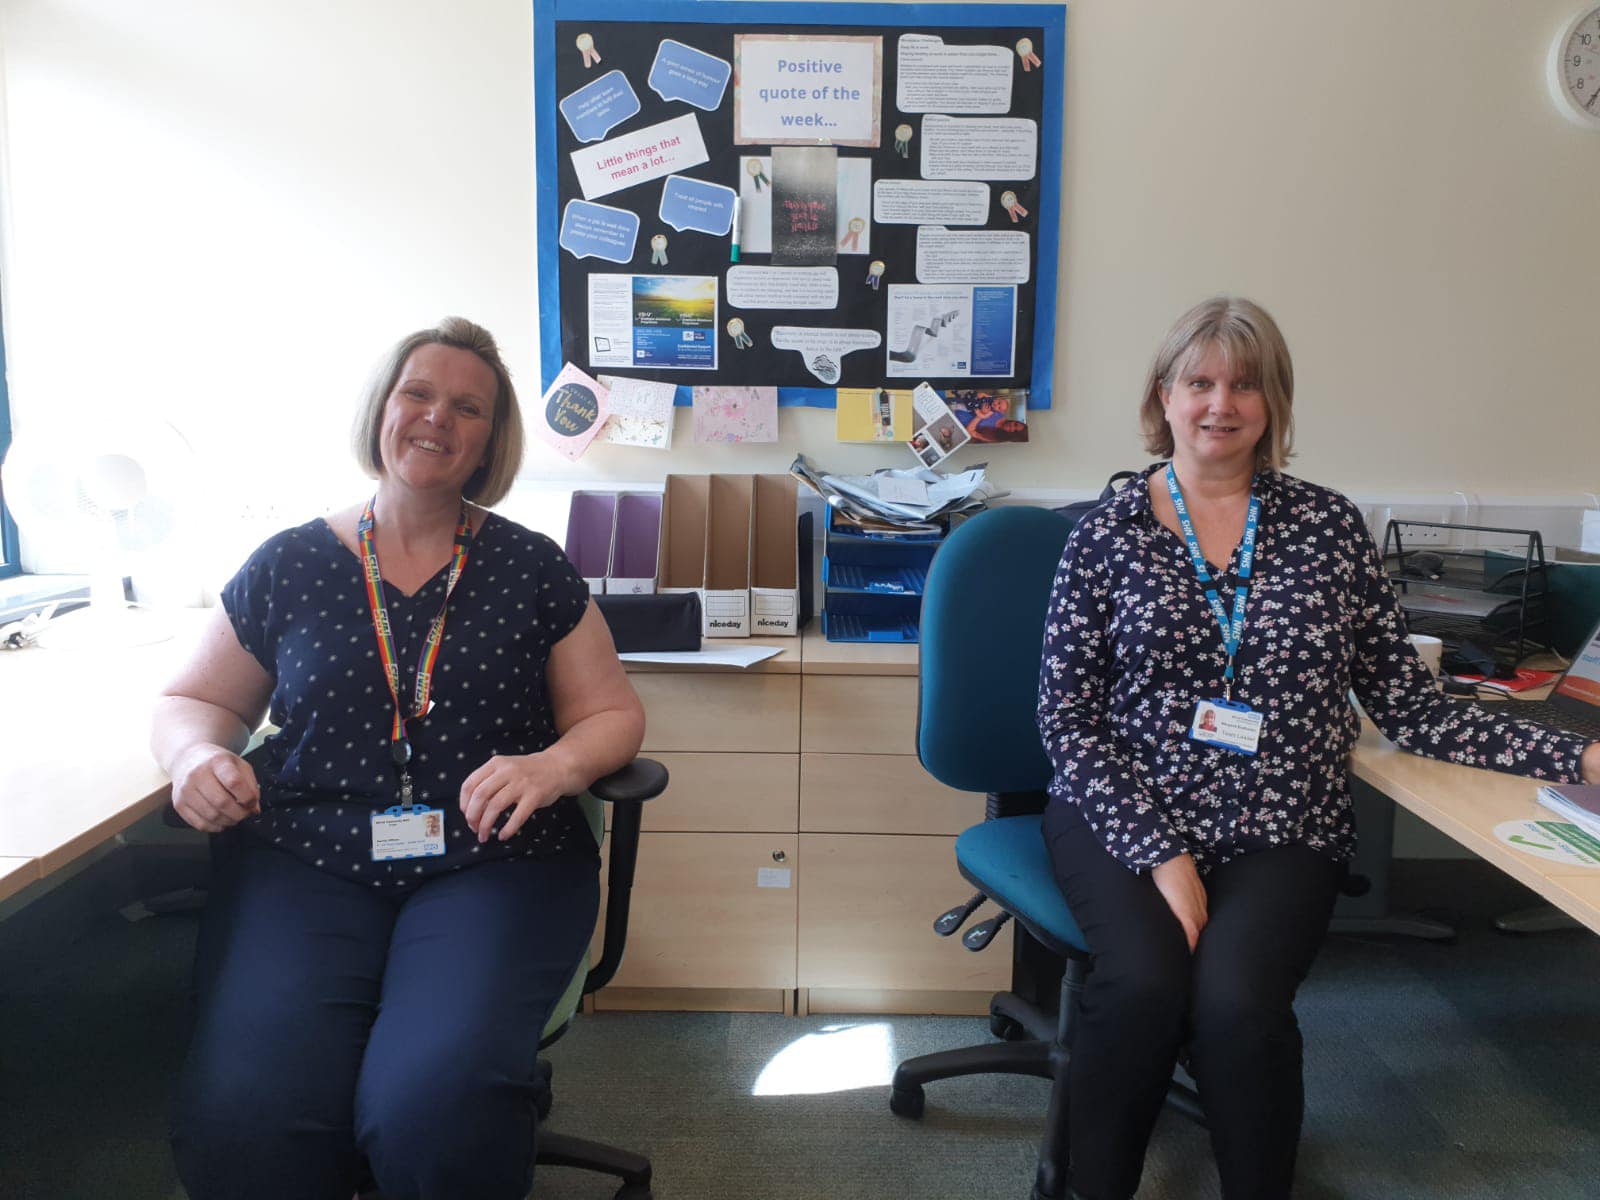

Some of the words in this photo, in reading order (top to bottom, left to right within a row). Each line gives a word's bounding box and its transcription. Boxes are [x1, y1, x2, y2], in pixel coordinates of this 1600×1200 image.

[1581, 33, 1592, 46] 10
[778, 59, 842, 73] Positive
[1573, 55, 1581, 67] 9
[1576, 78, 1584, 90] 8
[759, 88, 807, 102] quote
[812, 86, 829, 99] of
[833, 87, 860, 100] the
[781, 113, 837, 127] week...
[597, 156, 623, 170] Little
[625, 145, 658, 161] things
[660, 136, 680, 149] that
[611, 165, 640, 180] mean
[642, 161, 648, 170] a
[556, 389, 597, 422] Thank
[554, 407, 578, 431] You
[1168, 478, 1178, 494] NHS
[1174, 498, 1186, 514] NHS
[1248, 506, 1258, 523] NHS
[1182, 519, 1194, 536] NHS
[1244, 528, 1255, 545] NHS
[1189, 541, 1201, 558] NHS
[364, 555, 380, 582] NHS
[1241, 551, 1251, 569] NHS
[1211, 599, 1225, 617] NHS
[1235, 594, 1246, 613] NHS
[374, 608, 391, 636] NHS
[709, 620, 742, 629] niceday
[757, 618, 789, 628] niceday
[1232, 619, 1242, 641] NHS
[415, 672, 430, 703] NHS
